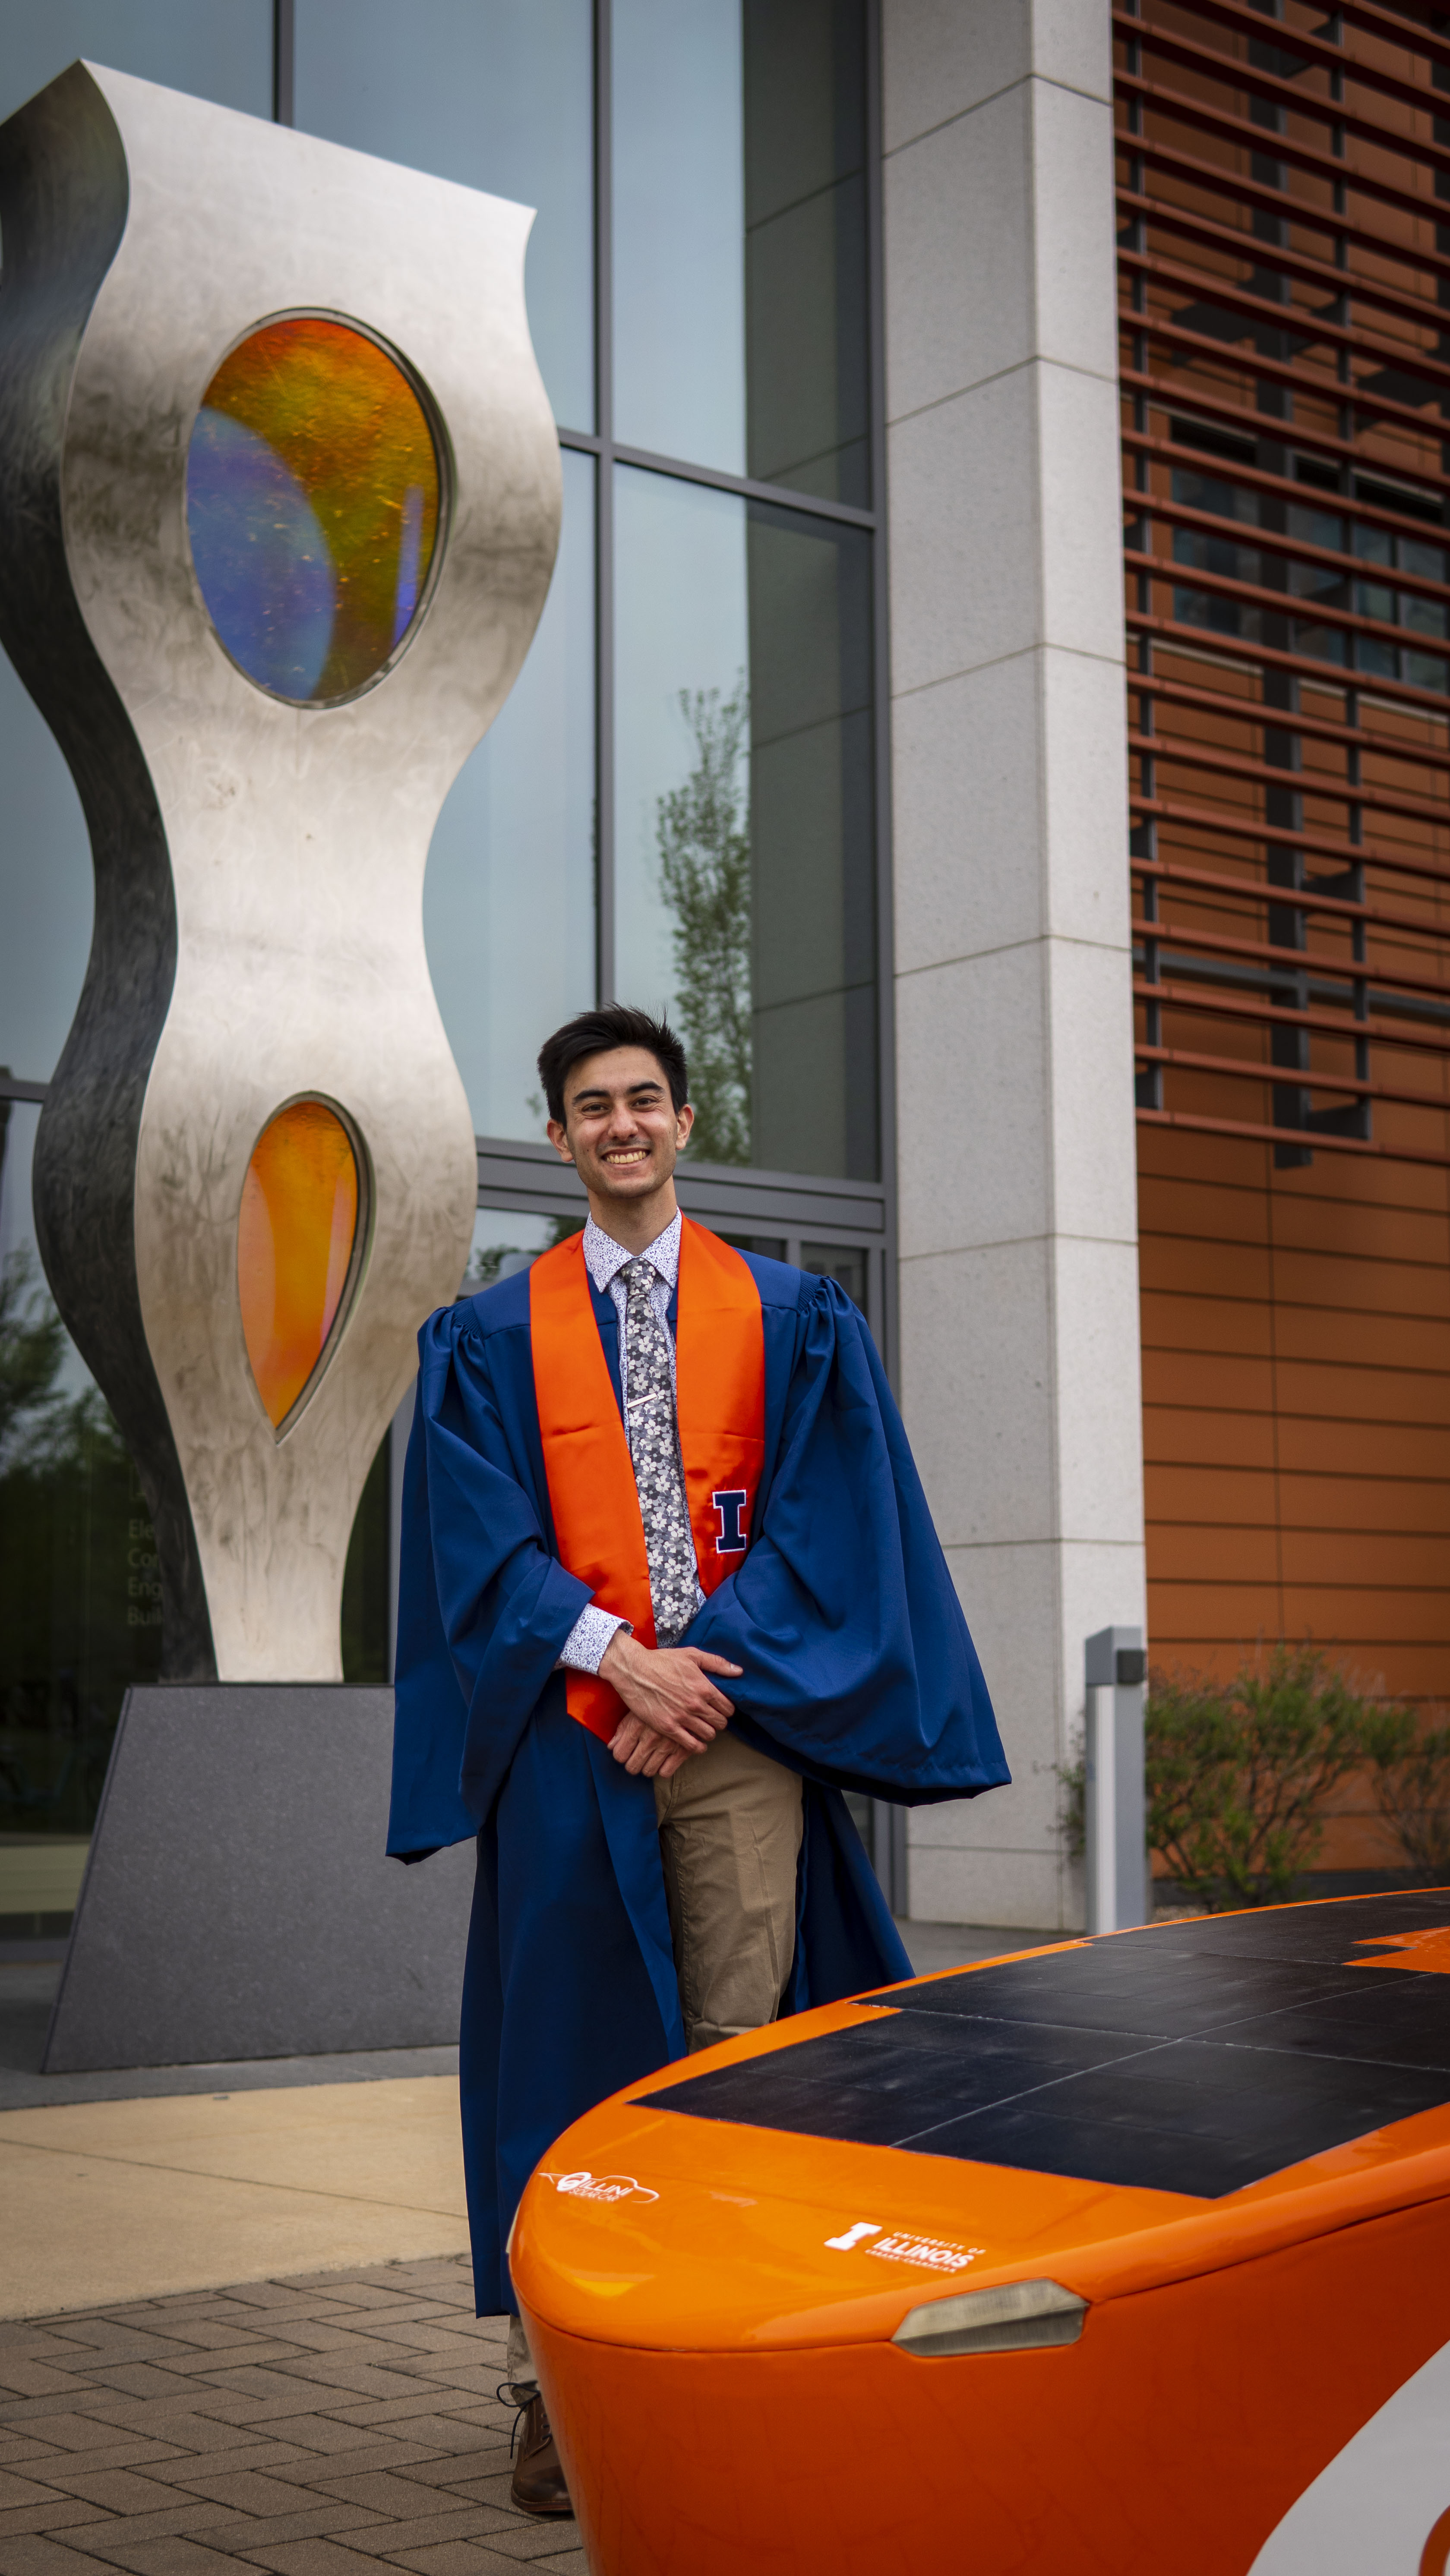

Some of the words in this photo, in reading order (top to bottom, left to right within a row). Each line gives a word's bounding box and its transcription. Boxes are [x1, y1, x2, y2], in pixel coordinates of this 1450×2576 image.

[712, 1489, 746, 1554] I
[569, 2187, 599, 2198] SOLAR
[597, 2192, 620, 2201] CAR
[872, 2237, 974, 2268] ILLINOIS
[892, 2231, 966, 2251] UNIVERSITY
